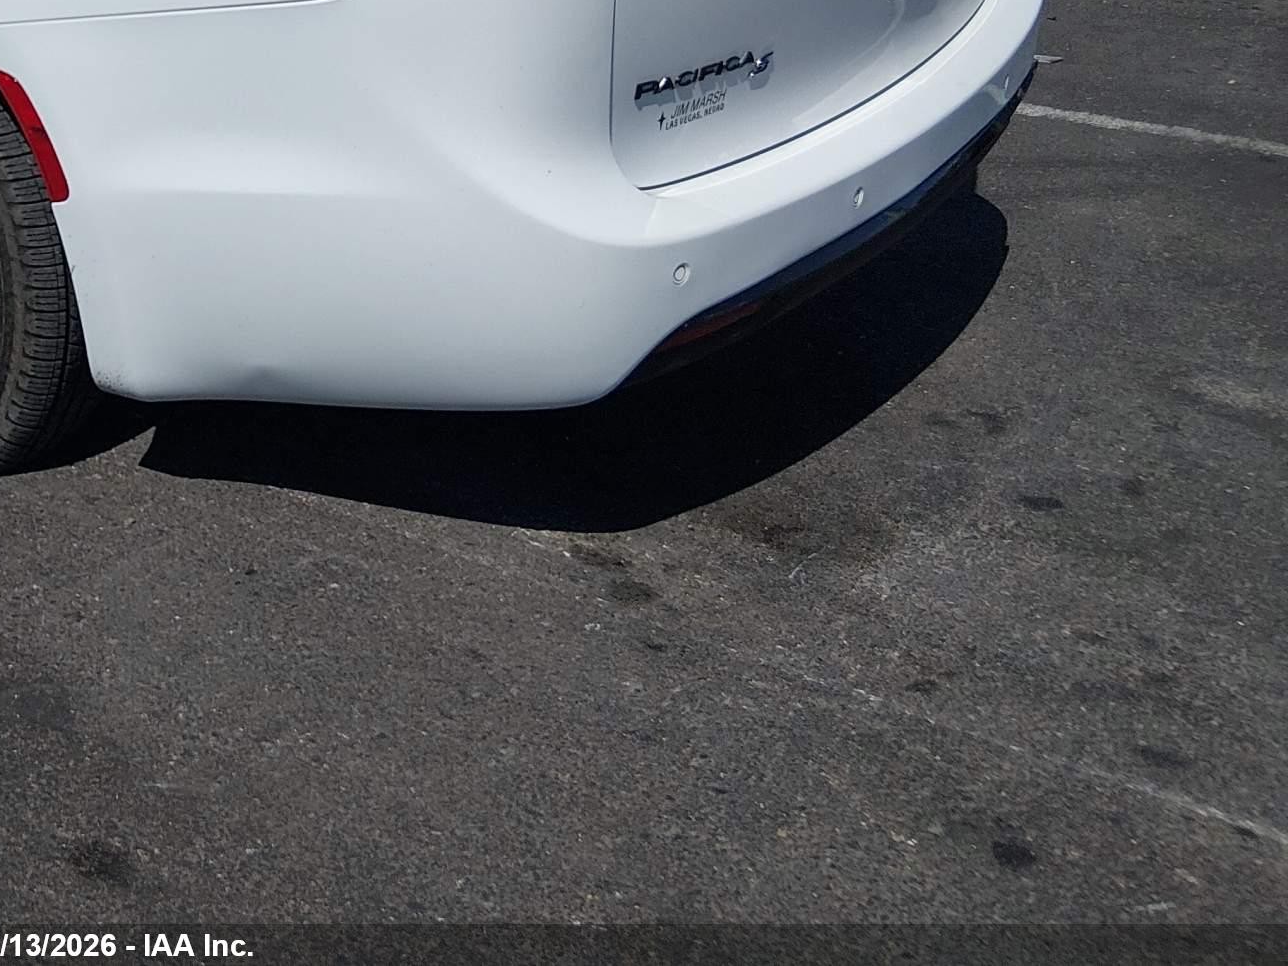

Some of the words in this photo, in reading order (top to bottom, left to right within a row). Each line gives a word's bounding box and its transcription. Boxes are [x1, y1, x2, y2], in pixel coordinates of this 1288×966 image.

[634, 51, 754, 100] PACIFICA
[671, 101, 690, 119] JIM
[691, 89, 727, 112] MARSH
[665, 118, 678, 131] LAS
